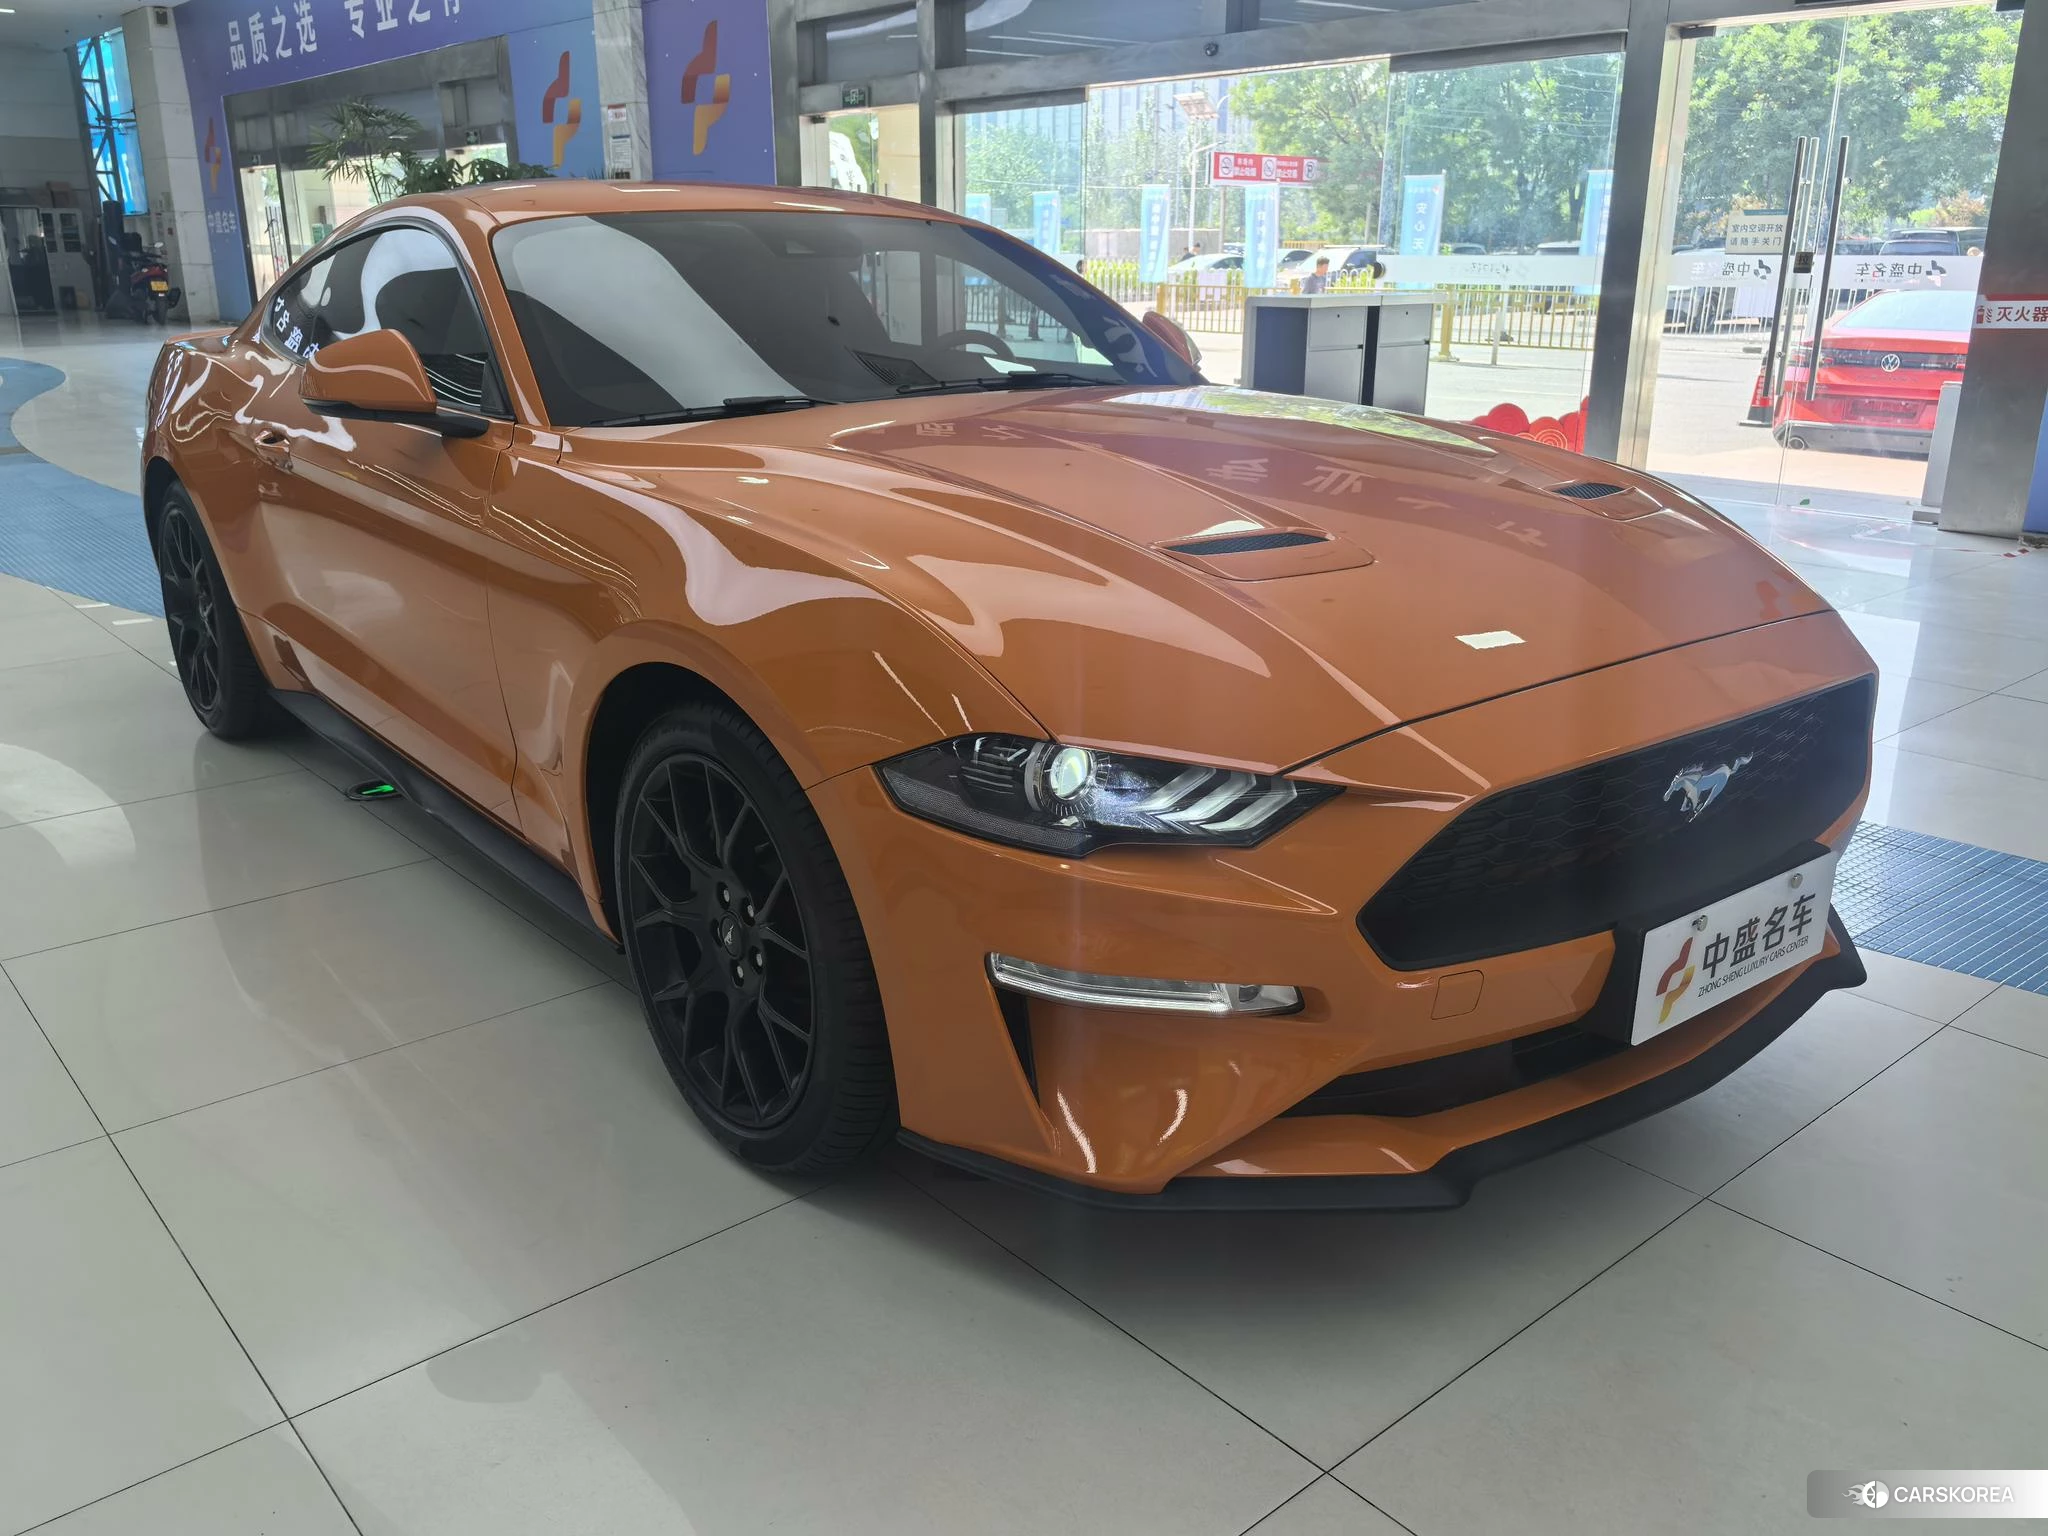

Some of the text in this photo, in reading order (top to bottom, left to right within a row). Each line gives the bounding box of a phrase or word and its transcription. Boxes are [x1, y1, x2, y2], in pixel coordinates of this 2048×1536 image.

[228, 2, 318, 71] 品质之选
[1729, 236, 1782, 246] 请随手关门
[1731, 223, 1784, 233] 室内空调开放
[1995, 305, 2048, 323] 灭火器
[1702, 892, 1816, 979] 中盛名车
[1698, 936, 1809, 998] ZHONG SHENG LUXURY CARS CENTER
